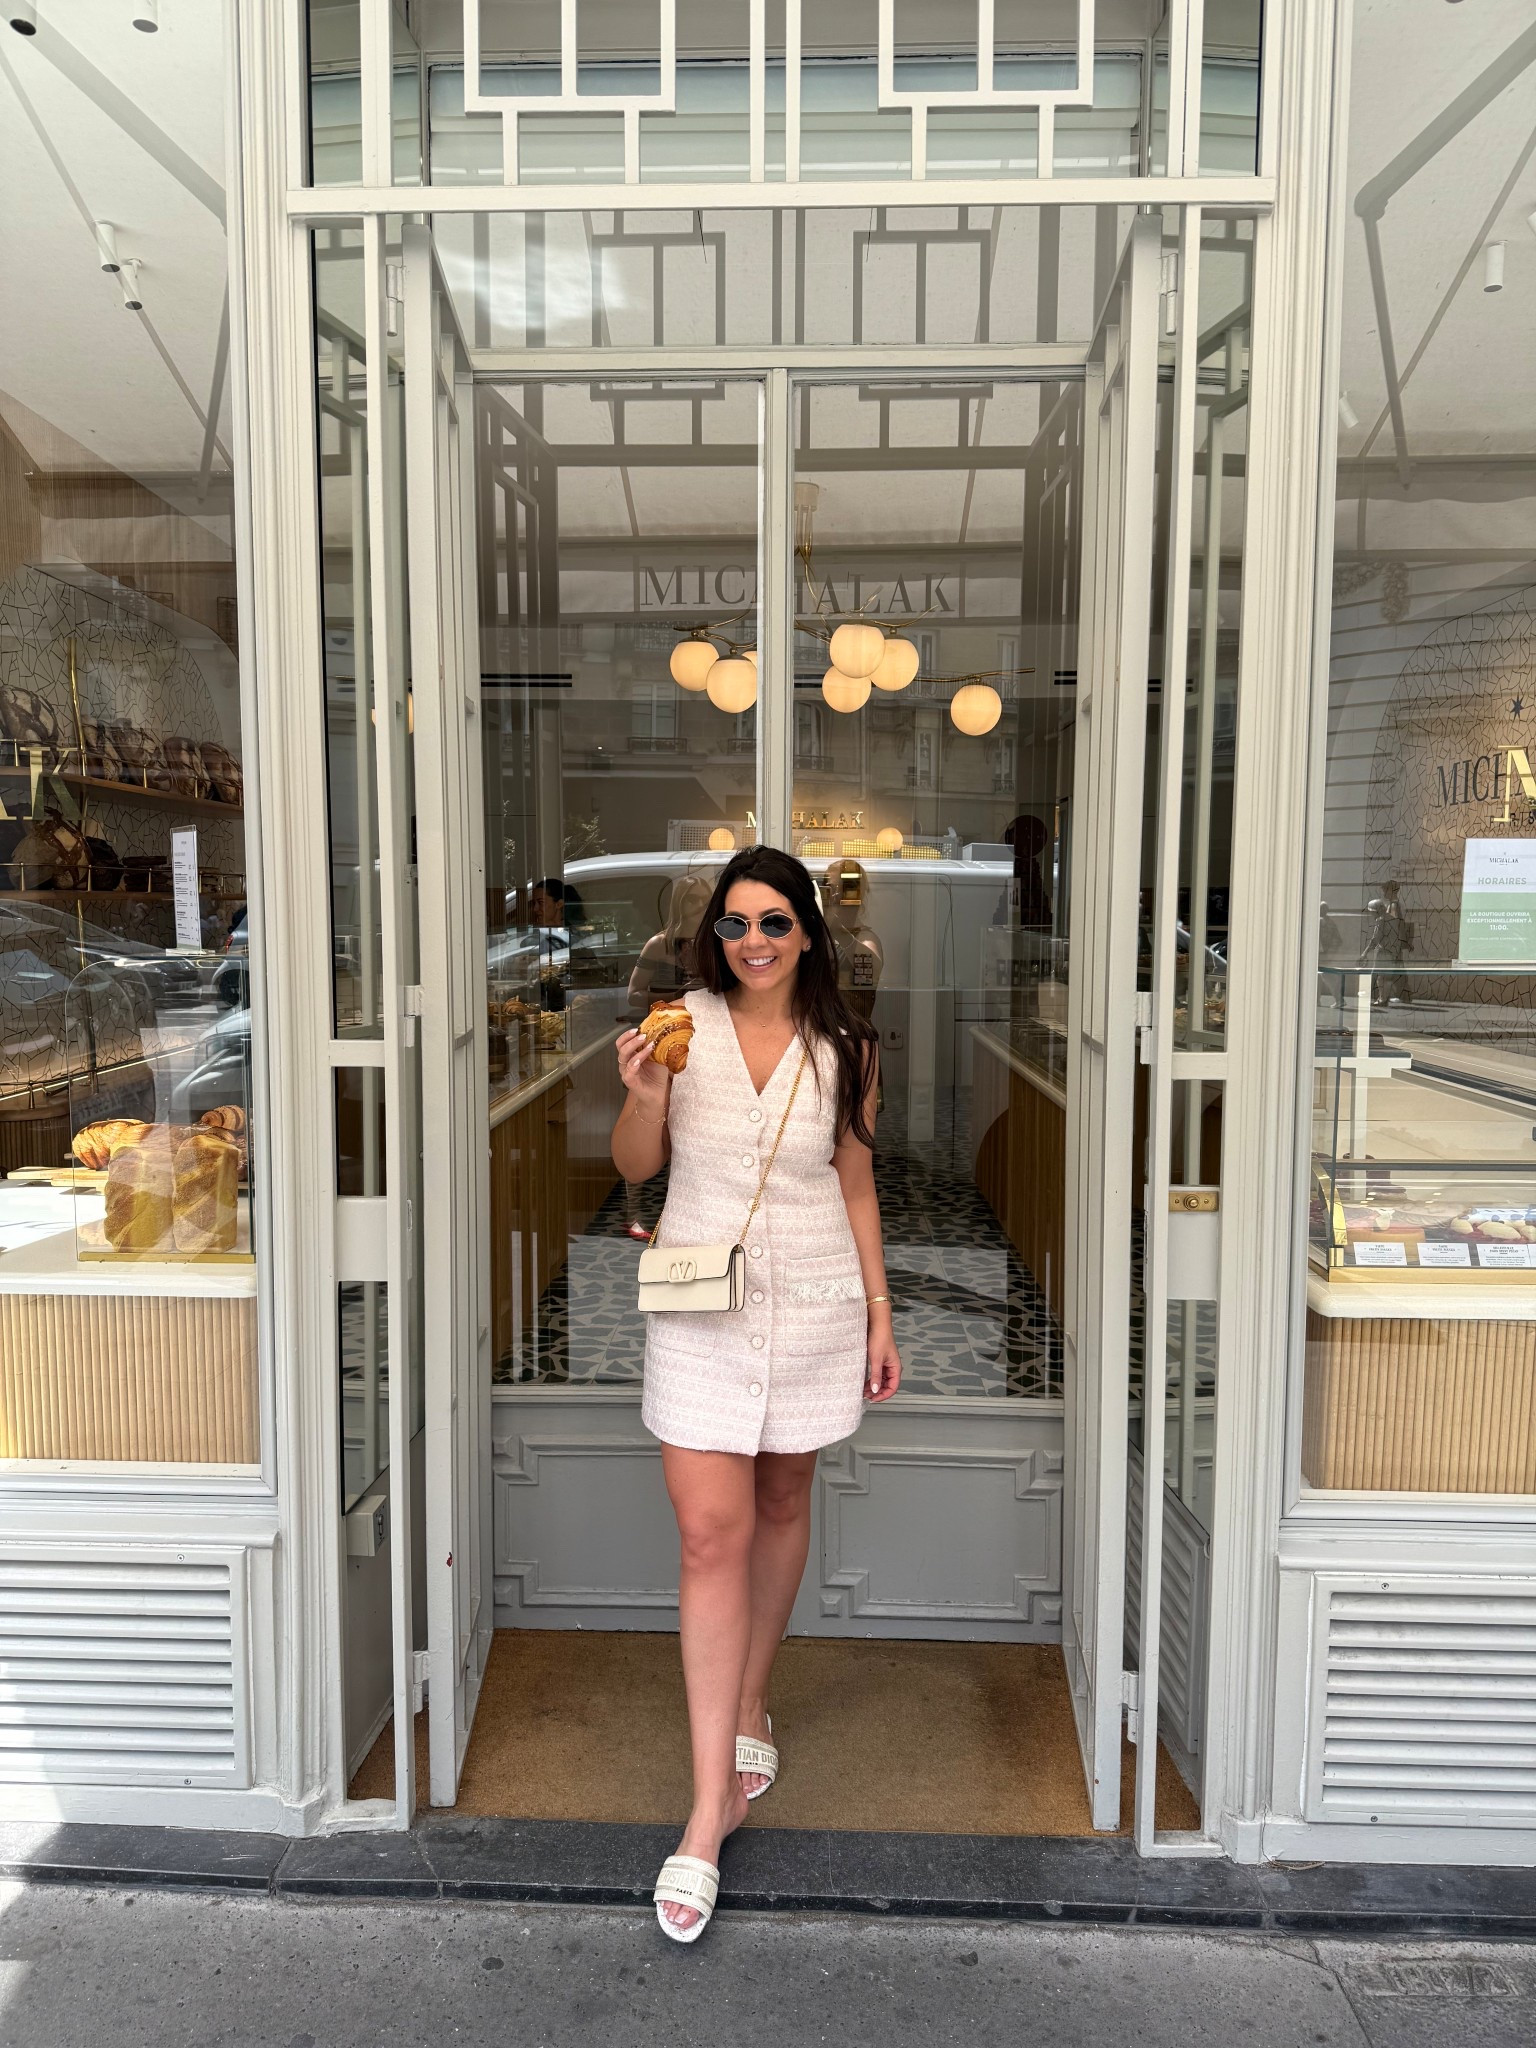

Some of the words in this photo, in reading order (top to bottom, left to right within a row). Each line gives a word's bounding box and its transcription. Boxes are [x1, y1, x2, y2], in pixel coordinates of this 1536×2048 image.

[745, 811, 865, 829] MHALAK
[1478, 877, 1527, 885] HORAIRES
[736, 1747, 759, 1762] TIAN
[675, 1887, 693, 1896] PARIS
